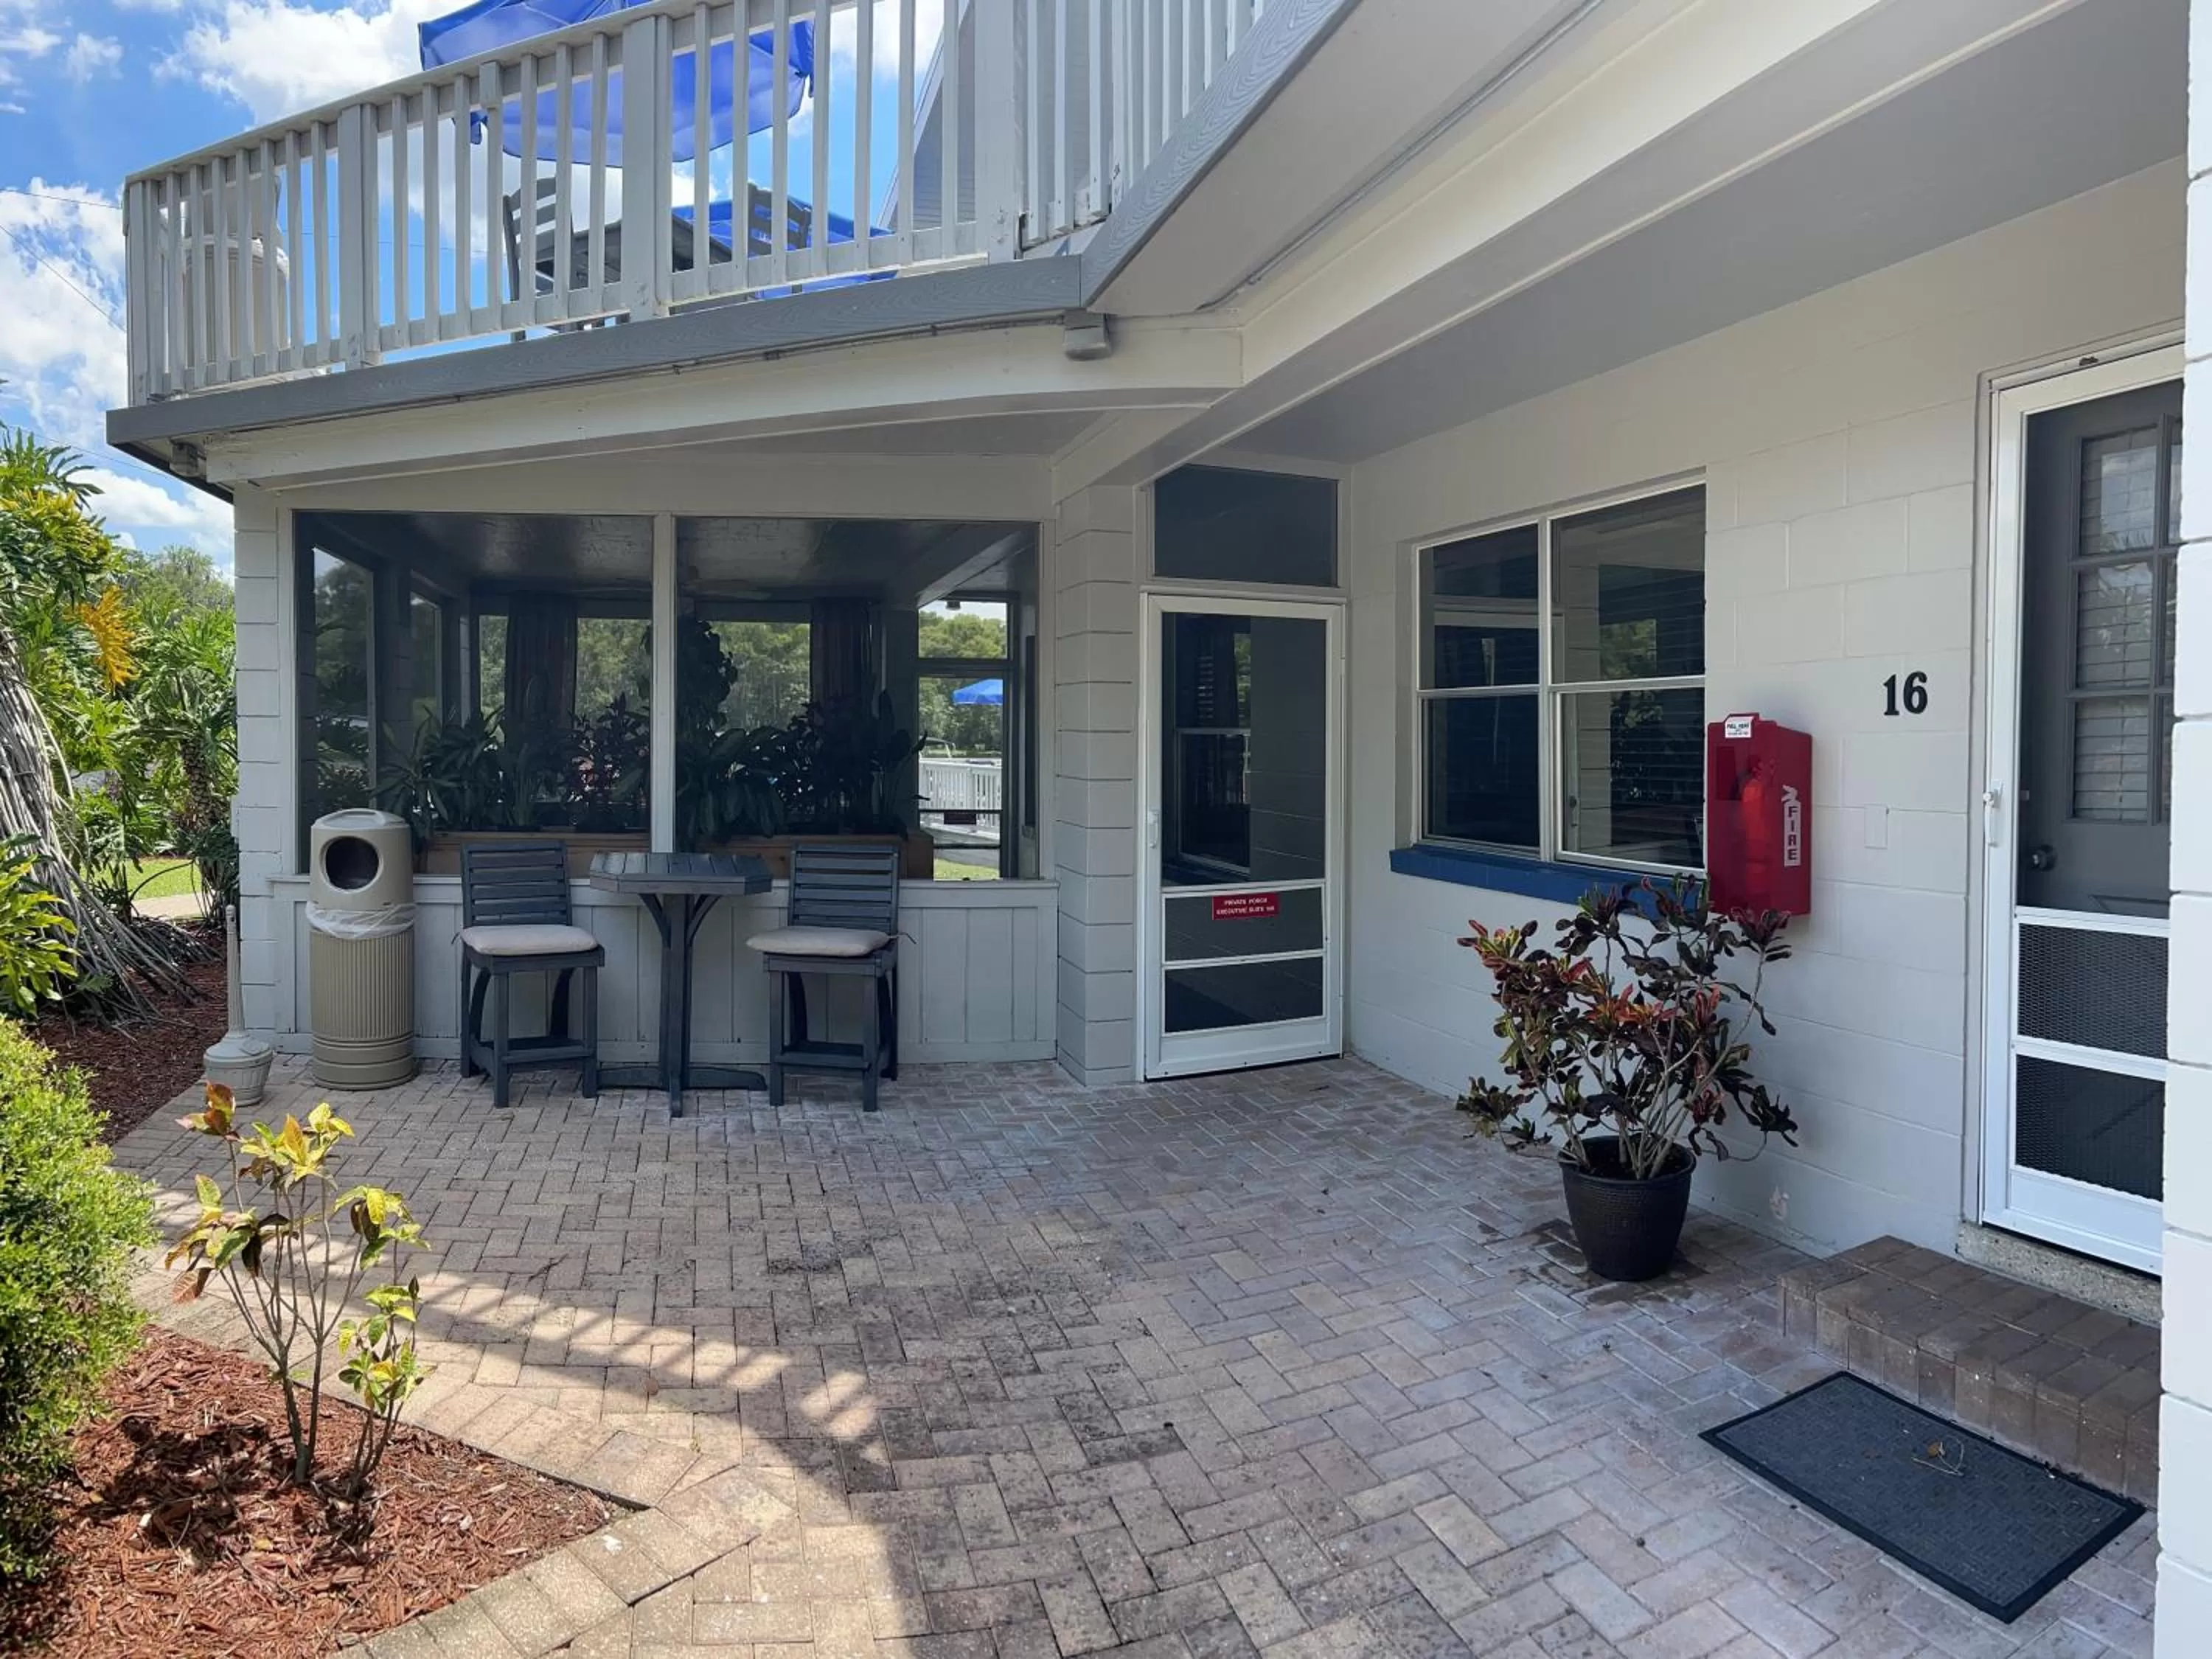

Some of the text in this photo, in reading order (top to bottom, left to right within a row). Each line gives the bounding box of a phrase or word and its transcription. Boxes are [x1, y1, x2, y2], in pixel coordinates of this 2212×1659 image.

[1882, 670, 1928, 716] 16
[1787, 806, 1798, 860] FIRE
[1224, 898, 1247, 906] PRIVATE
